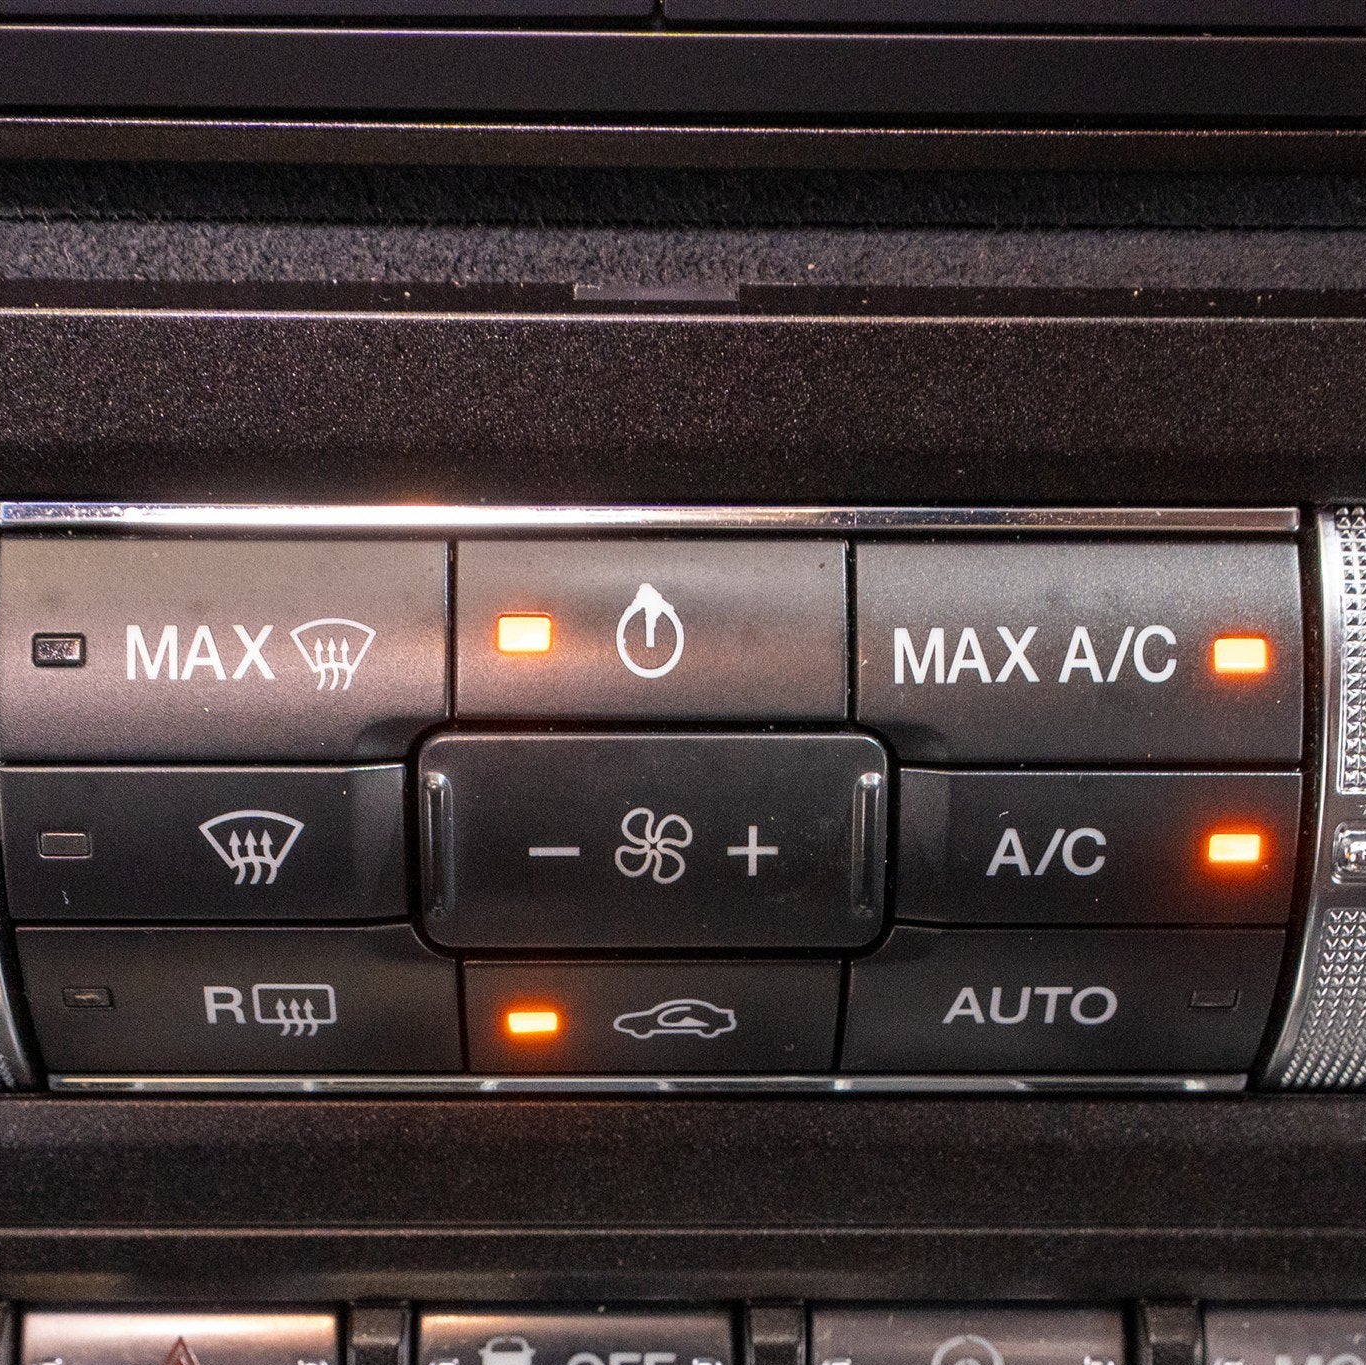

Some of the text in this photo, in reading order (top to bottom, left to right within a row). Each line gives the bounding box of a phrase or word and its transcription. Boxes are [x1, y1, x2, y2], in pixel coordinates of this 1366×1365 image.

[124, 625, 276, 681] MAX
[893, 625, 1178, 685] MAX A/C
[986, 828, 1107, 877] A/C
[203, 986, 247, 1025] R
[942, 986, 1118, 1026] AUTO
